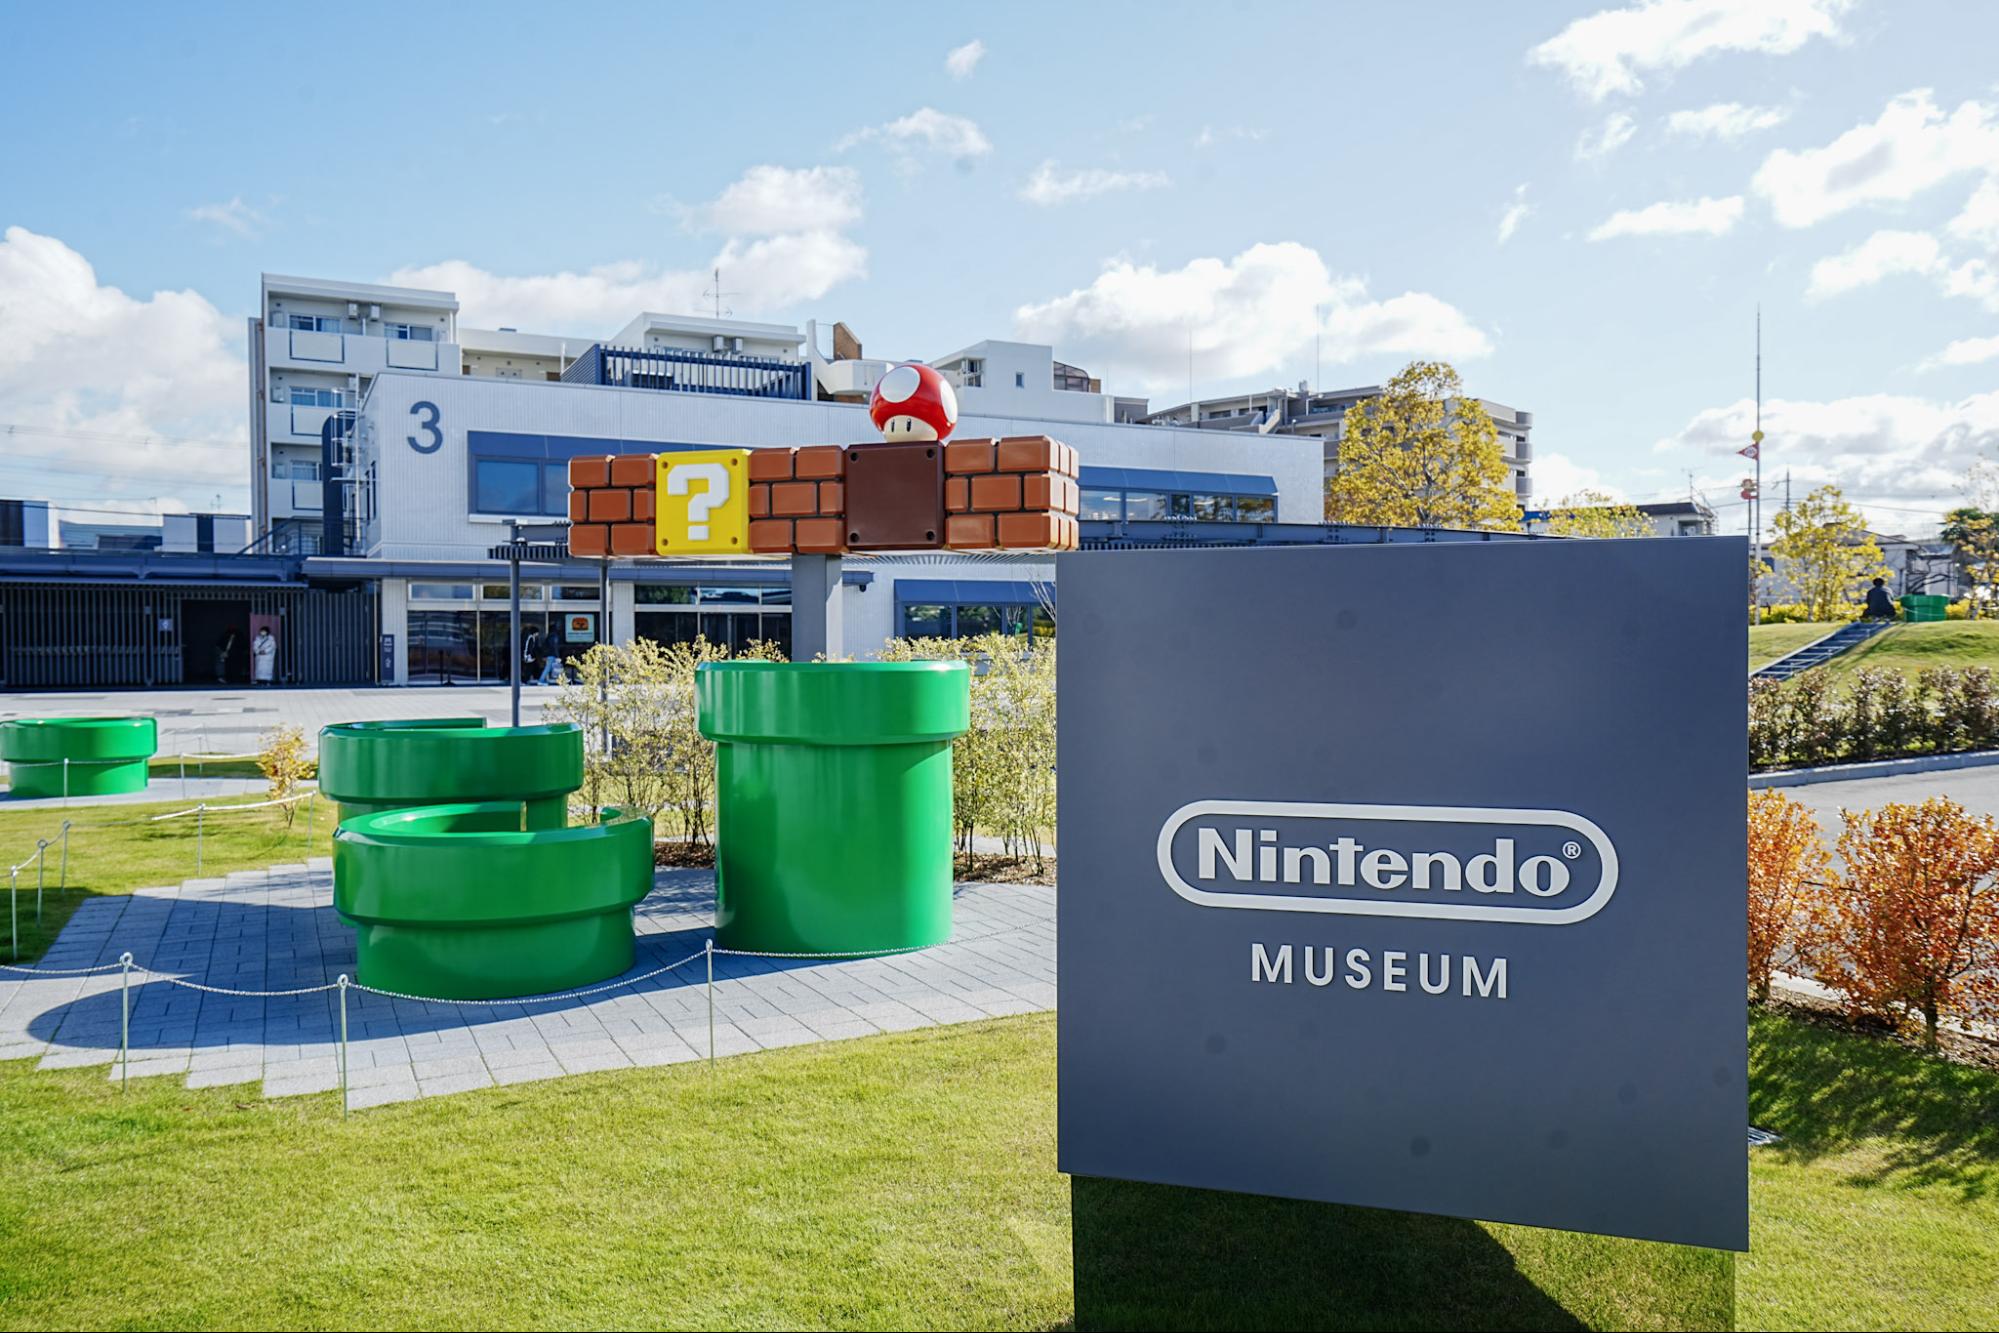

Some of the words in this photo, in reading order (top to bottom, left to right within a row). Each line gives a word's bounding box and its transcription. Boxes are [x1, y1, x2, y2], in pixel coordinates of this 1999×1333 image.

[406, 400, 444, 455] 3
[667, 462, 730, 541] ?
[1251, 943, 1507, 999] MUSEUM
